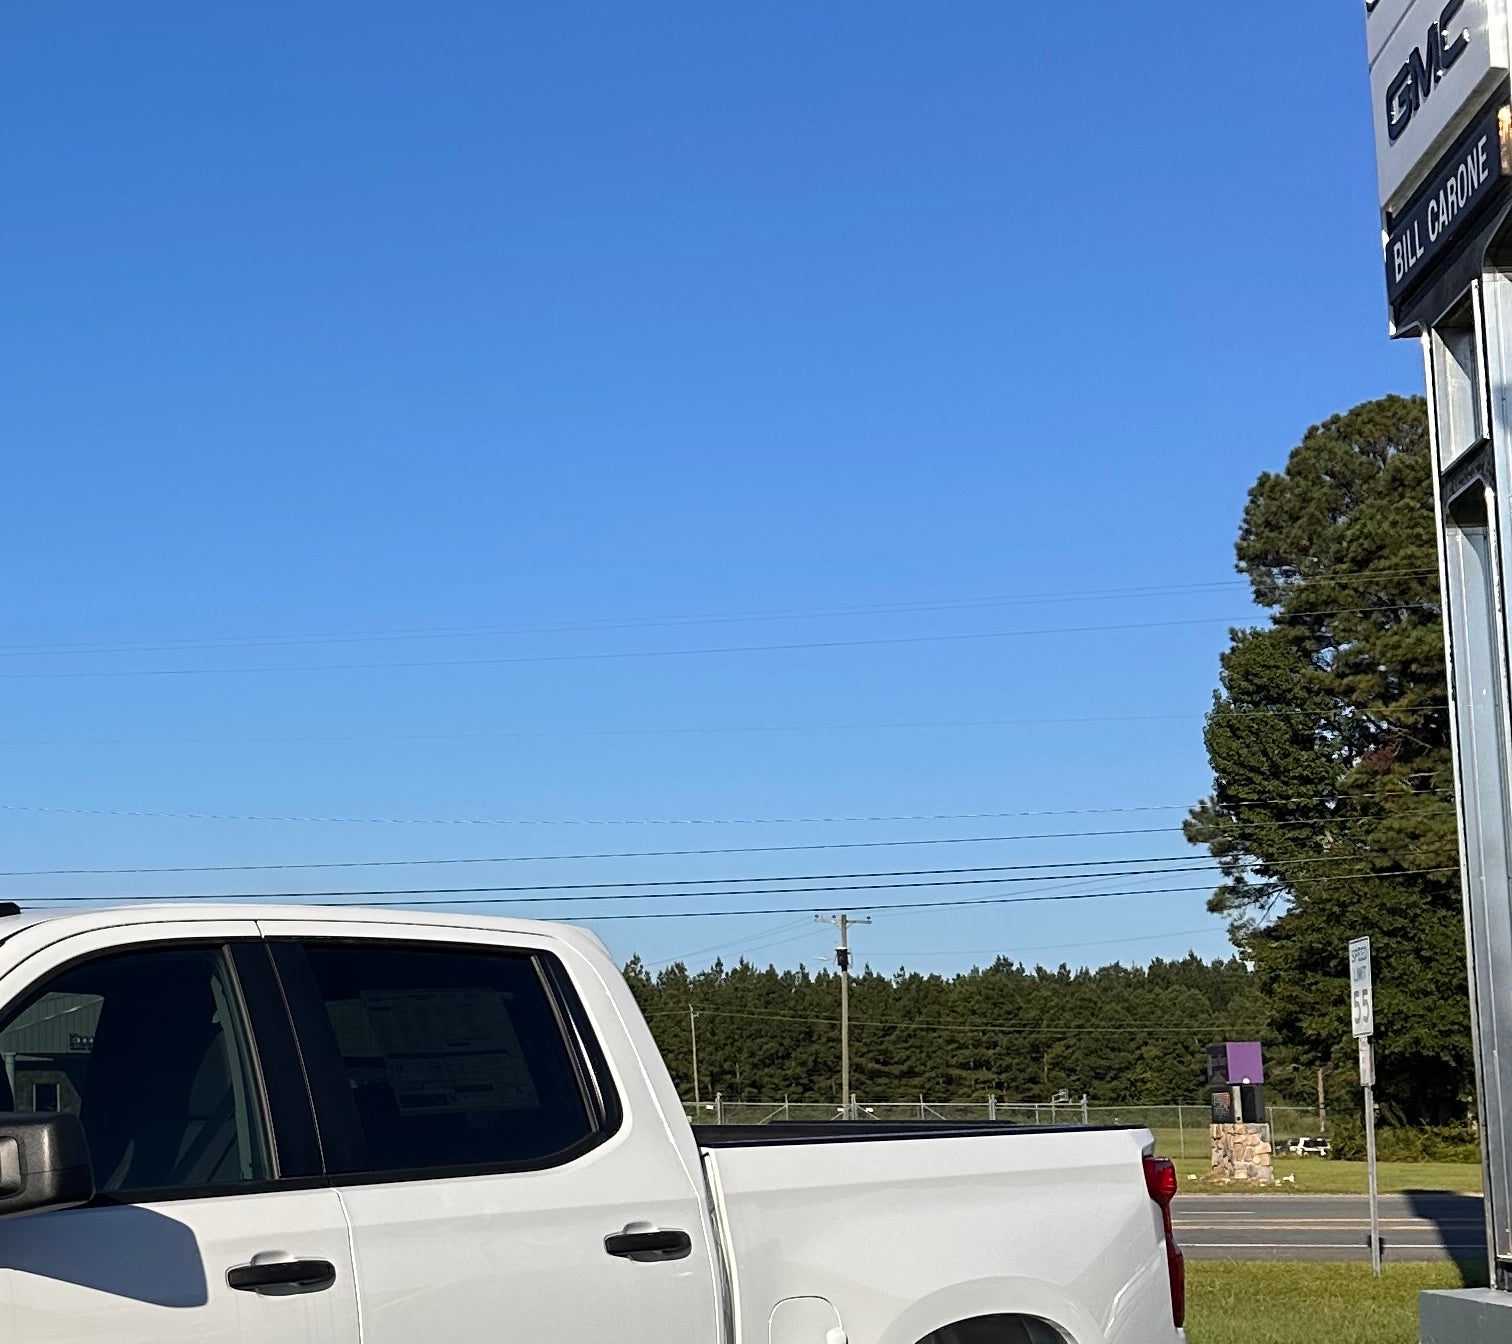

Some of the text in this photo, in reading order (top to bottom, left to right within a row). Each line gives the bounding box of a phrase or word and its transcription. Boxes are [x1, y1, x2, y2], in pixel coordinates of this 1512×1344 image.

[1393, 134, 1489, 284] BILL CARONE
[1353, 988, 1370, 1025] 55
